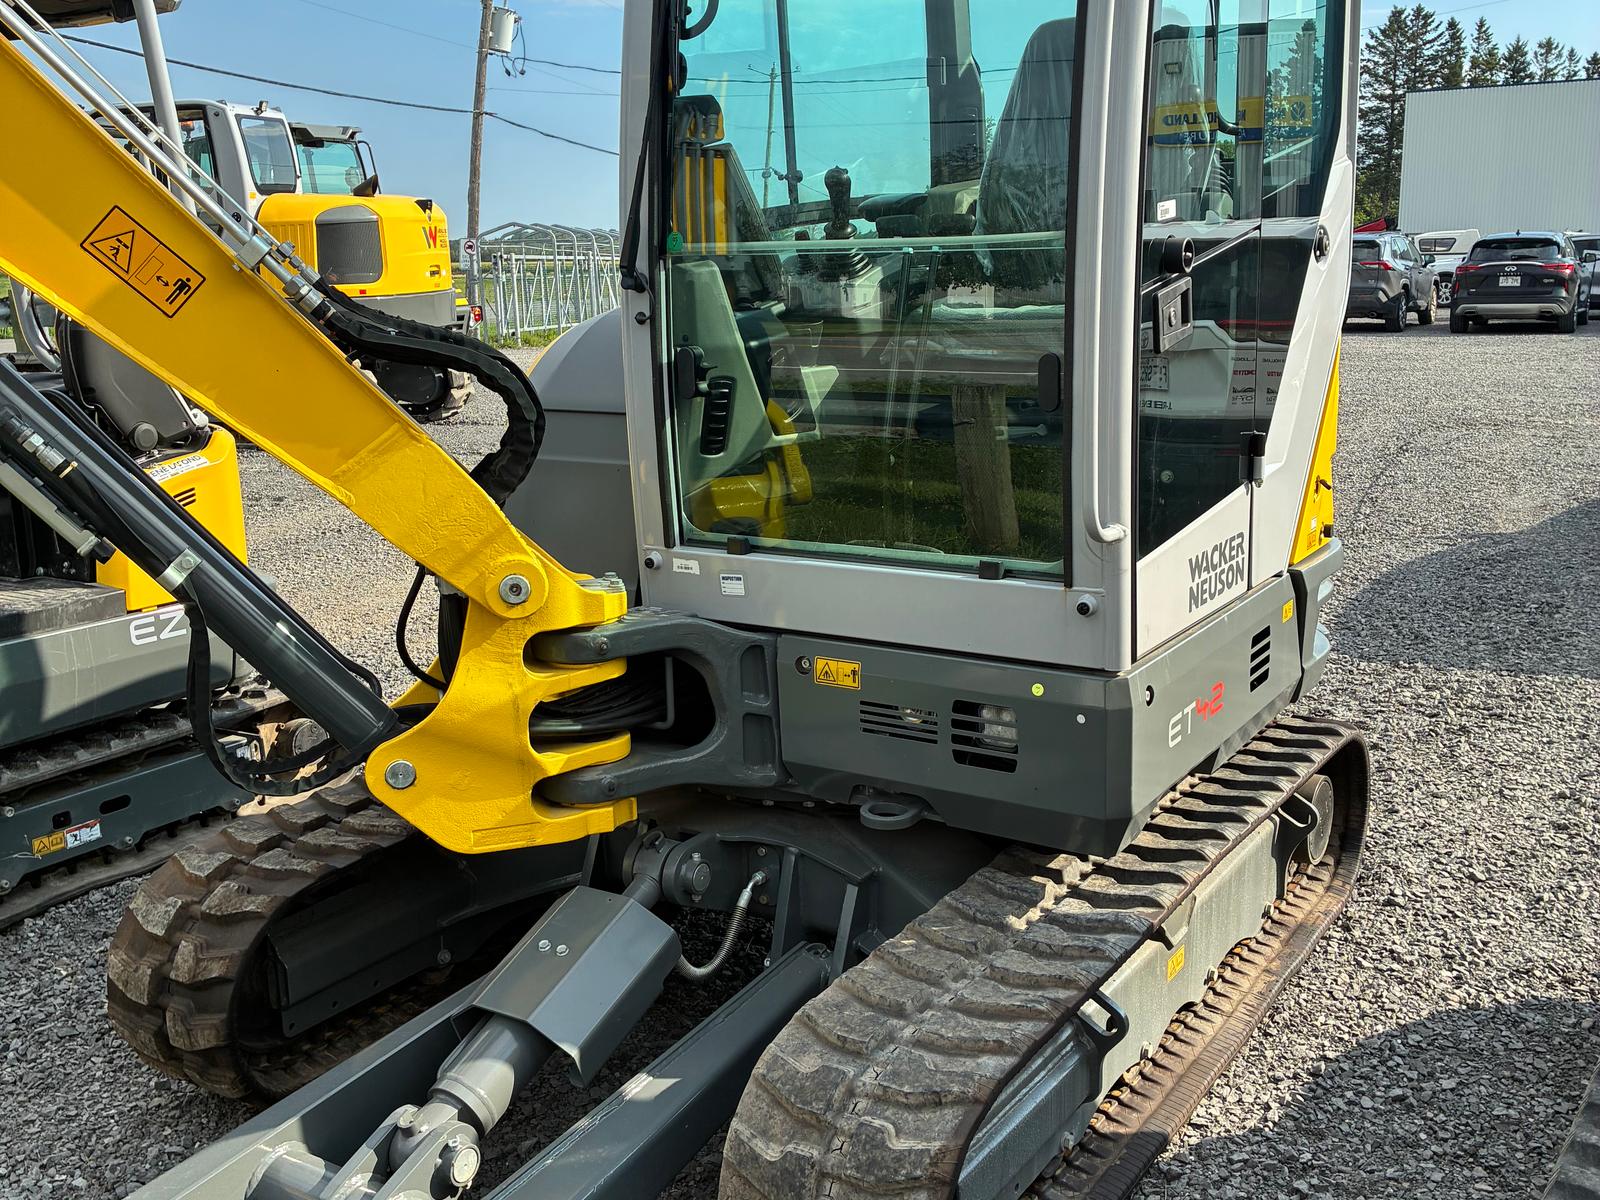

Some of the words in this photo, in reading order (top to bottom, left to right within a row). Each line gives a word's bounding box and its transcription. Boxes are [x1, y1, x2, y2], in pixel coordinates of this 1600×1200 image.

[1188, 532, 1245, 582] WACKER
[1188, 557, 1245, 613] NEUSON
[130, 610, 187, 646] EZ
[1168, 681, 1225, 748] ET42
